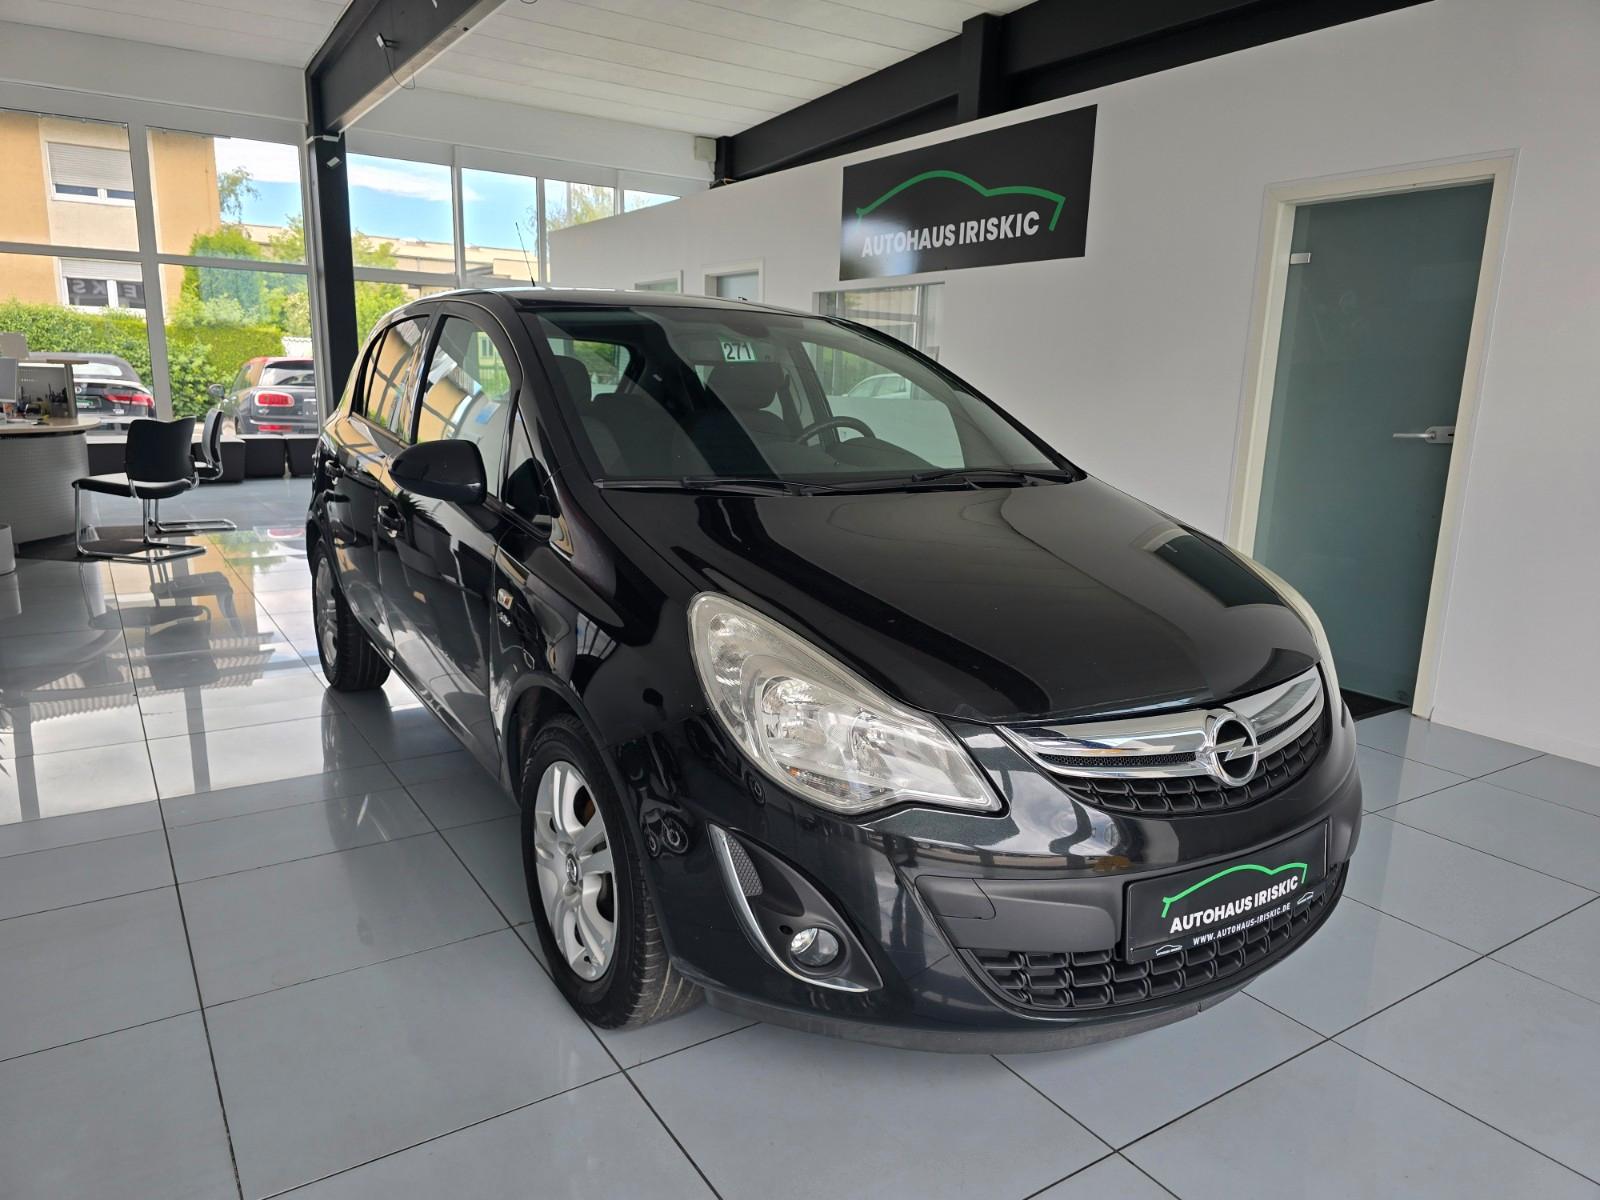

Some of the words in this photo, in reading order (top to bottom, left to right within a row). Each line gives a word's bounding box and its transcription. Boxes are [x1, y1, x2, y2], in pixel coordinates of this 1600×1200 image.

[861, 225, 956, 257] AUTOHAUS
[958, 211, 1040, 245] IRISKIC
[723, 342, 752, 360] 271
[1169, 898, 1253, 934] AUTOHAUS
[1253, 875, 1299, 907] IRISKIC
